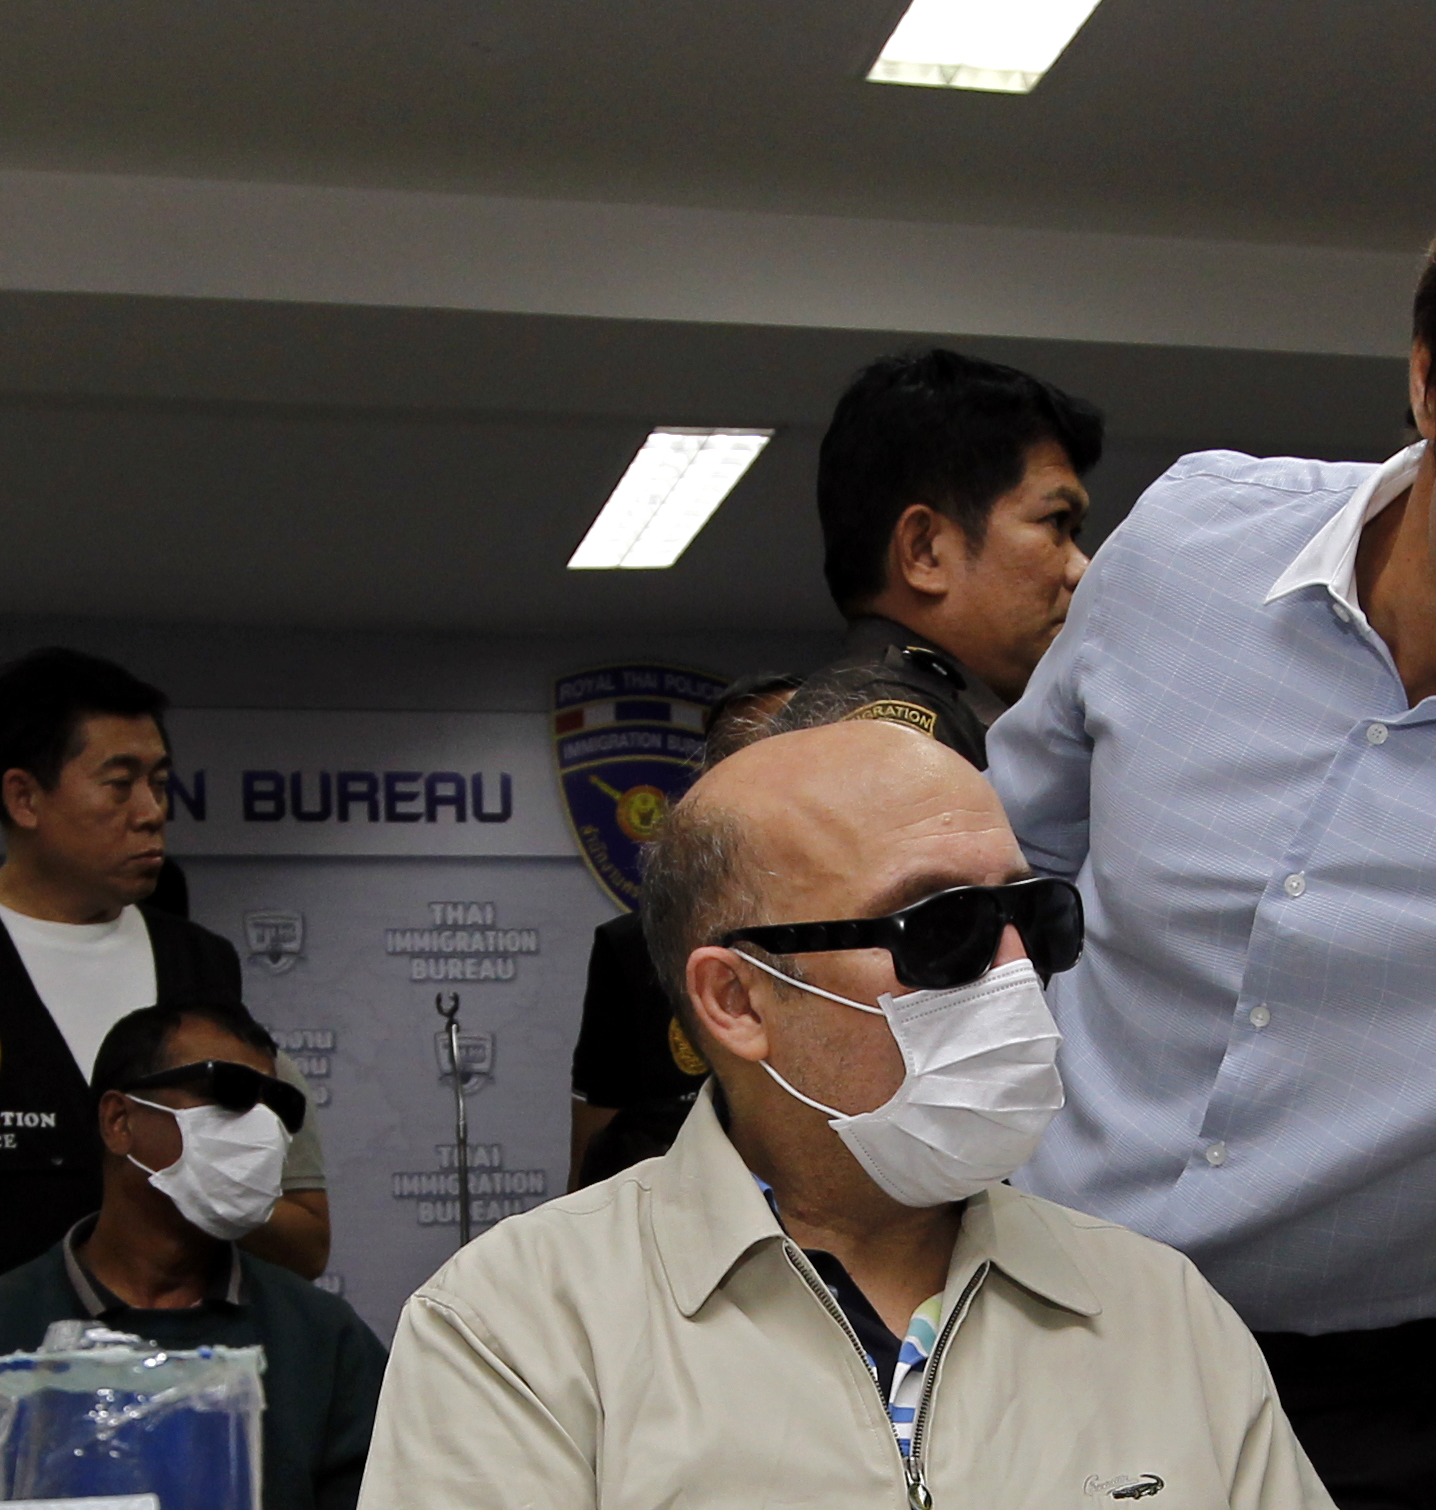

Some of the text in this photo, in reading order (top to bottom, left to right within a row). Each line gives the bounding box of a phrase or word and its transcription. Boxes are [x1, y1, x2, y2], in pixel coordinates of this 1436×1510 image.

[622, 670, 659, 689] THAI
[242, 770, 513, 822] BUREAU
[429, 901, 495, 926] THAI
[385, 928, 539, 954] IMMIGRATION
[411, 956, 516, 981] BUREAU
